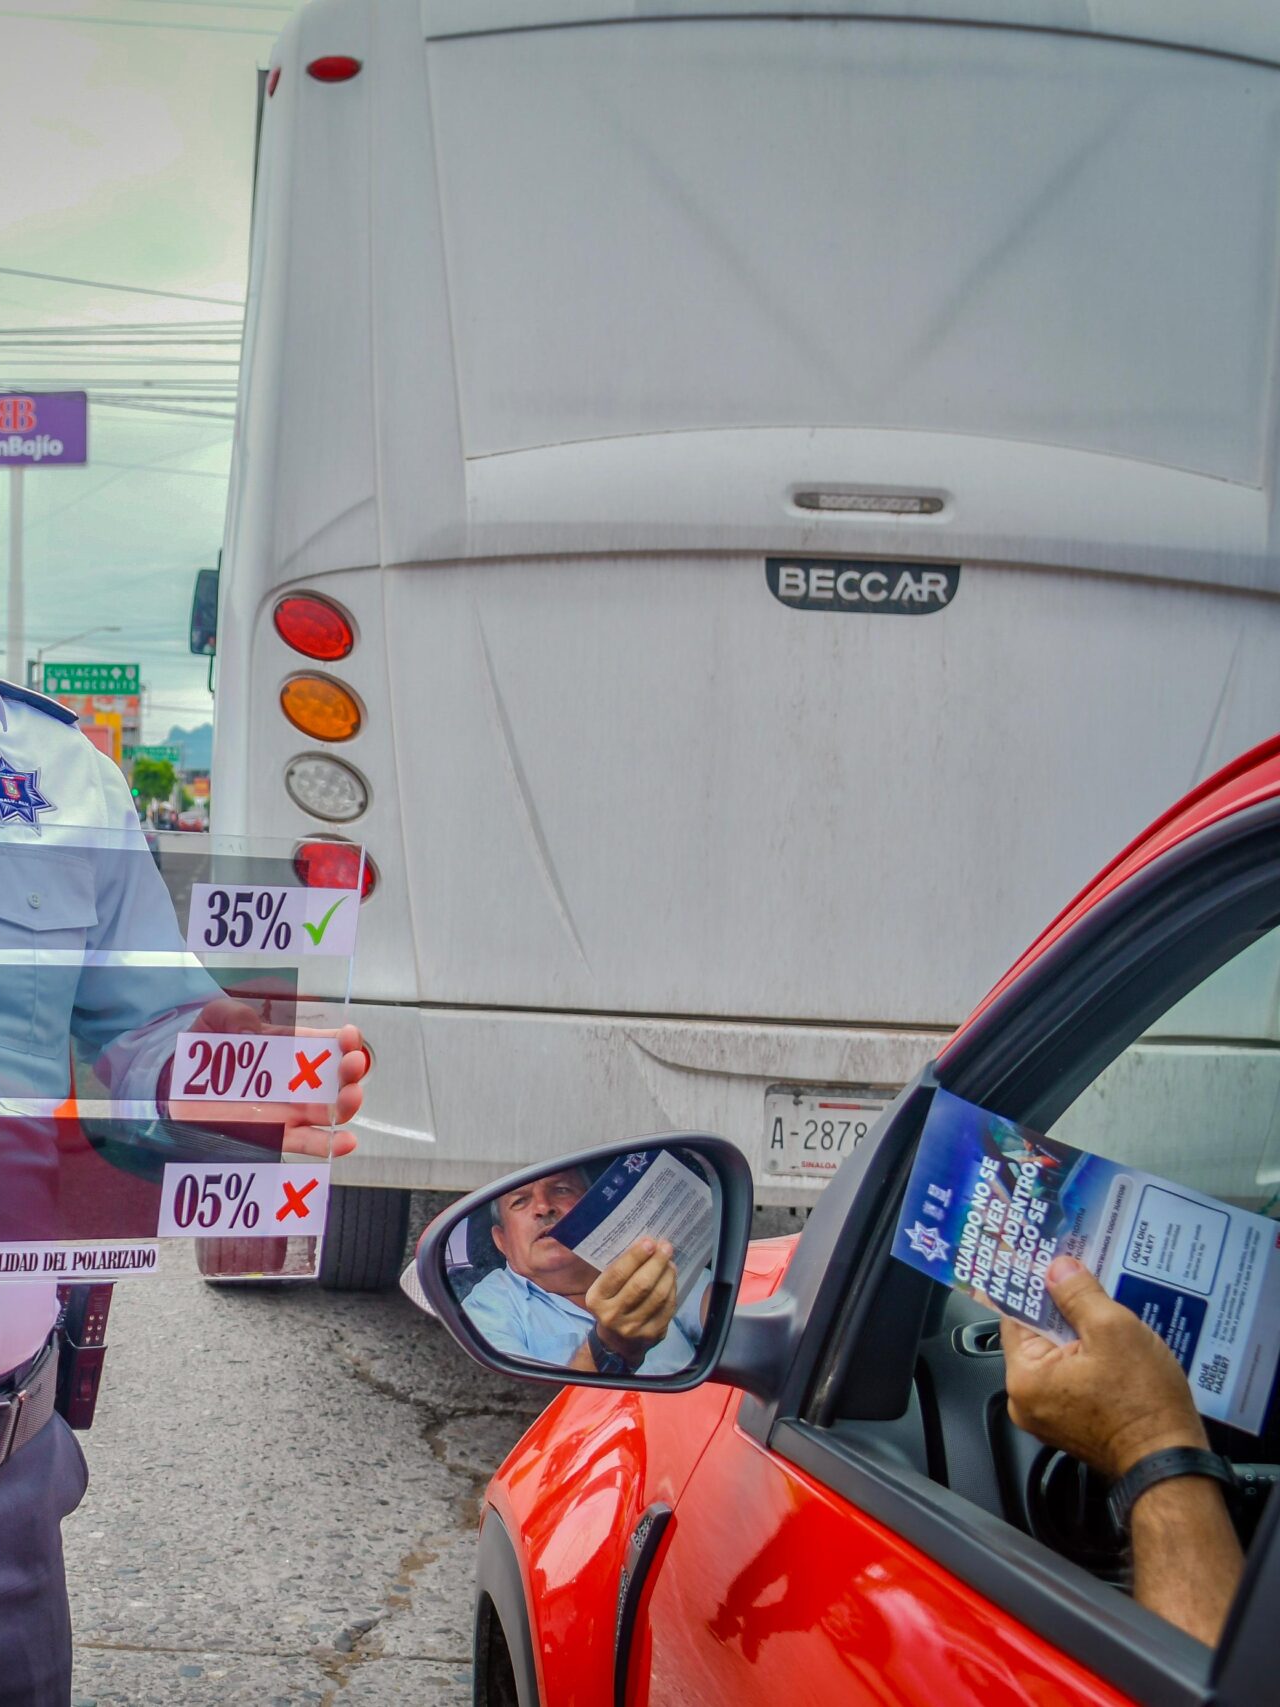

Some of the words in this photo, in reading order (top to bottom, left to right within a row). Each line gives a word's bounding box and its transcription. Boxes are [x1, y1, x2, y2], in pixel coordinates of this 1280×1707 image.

[777, 566, 950, 604] BECCAR
[204, 890, 292, 950] 35%
[183, 1040, 273, 1098] 20%
[801, 1160, 838, 1170] SINALOA
[979, 1155, 1000, 1181] SE
[173, 1172, 260, 1230] 05%
[972, 1183, 992, 1210] NO
[1027, 1198, 1048, 1224] SE
[988, 1249, 1013, 1302] HACIA
[1002, 1161, 1042, 1249] ADENTRO,
[1070, 1207, 1086, 1236] norma
[1136, 1220, 1149, 1240] DICE
[42, 1251, 68, 1272] DEL
[72, 1249, 157, 1271] POLARIZADO
[953, 1210, 984, 1281] CUANDO
[970, 1234, 997, 1292] PUEDE
[984, 1198, 1007, 1230] VER
[1010, 1223, 1040, 1289] RIESGO
[1067, 1238, 1076, 1250] de
[1140, 1255, 1150, 1266] LA
[1144, 1234, 1156, 1254] LEY?
[1024, 1237, 1058, 1321] ESCONDE.
[1005, 1290, 1024, 1311] EL
[1205, 1353, 1222, 1392] PUEDES
[1213, 1356, 1230, 1395] HACER?
